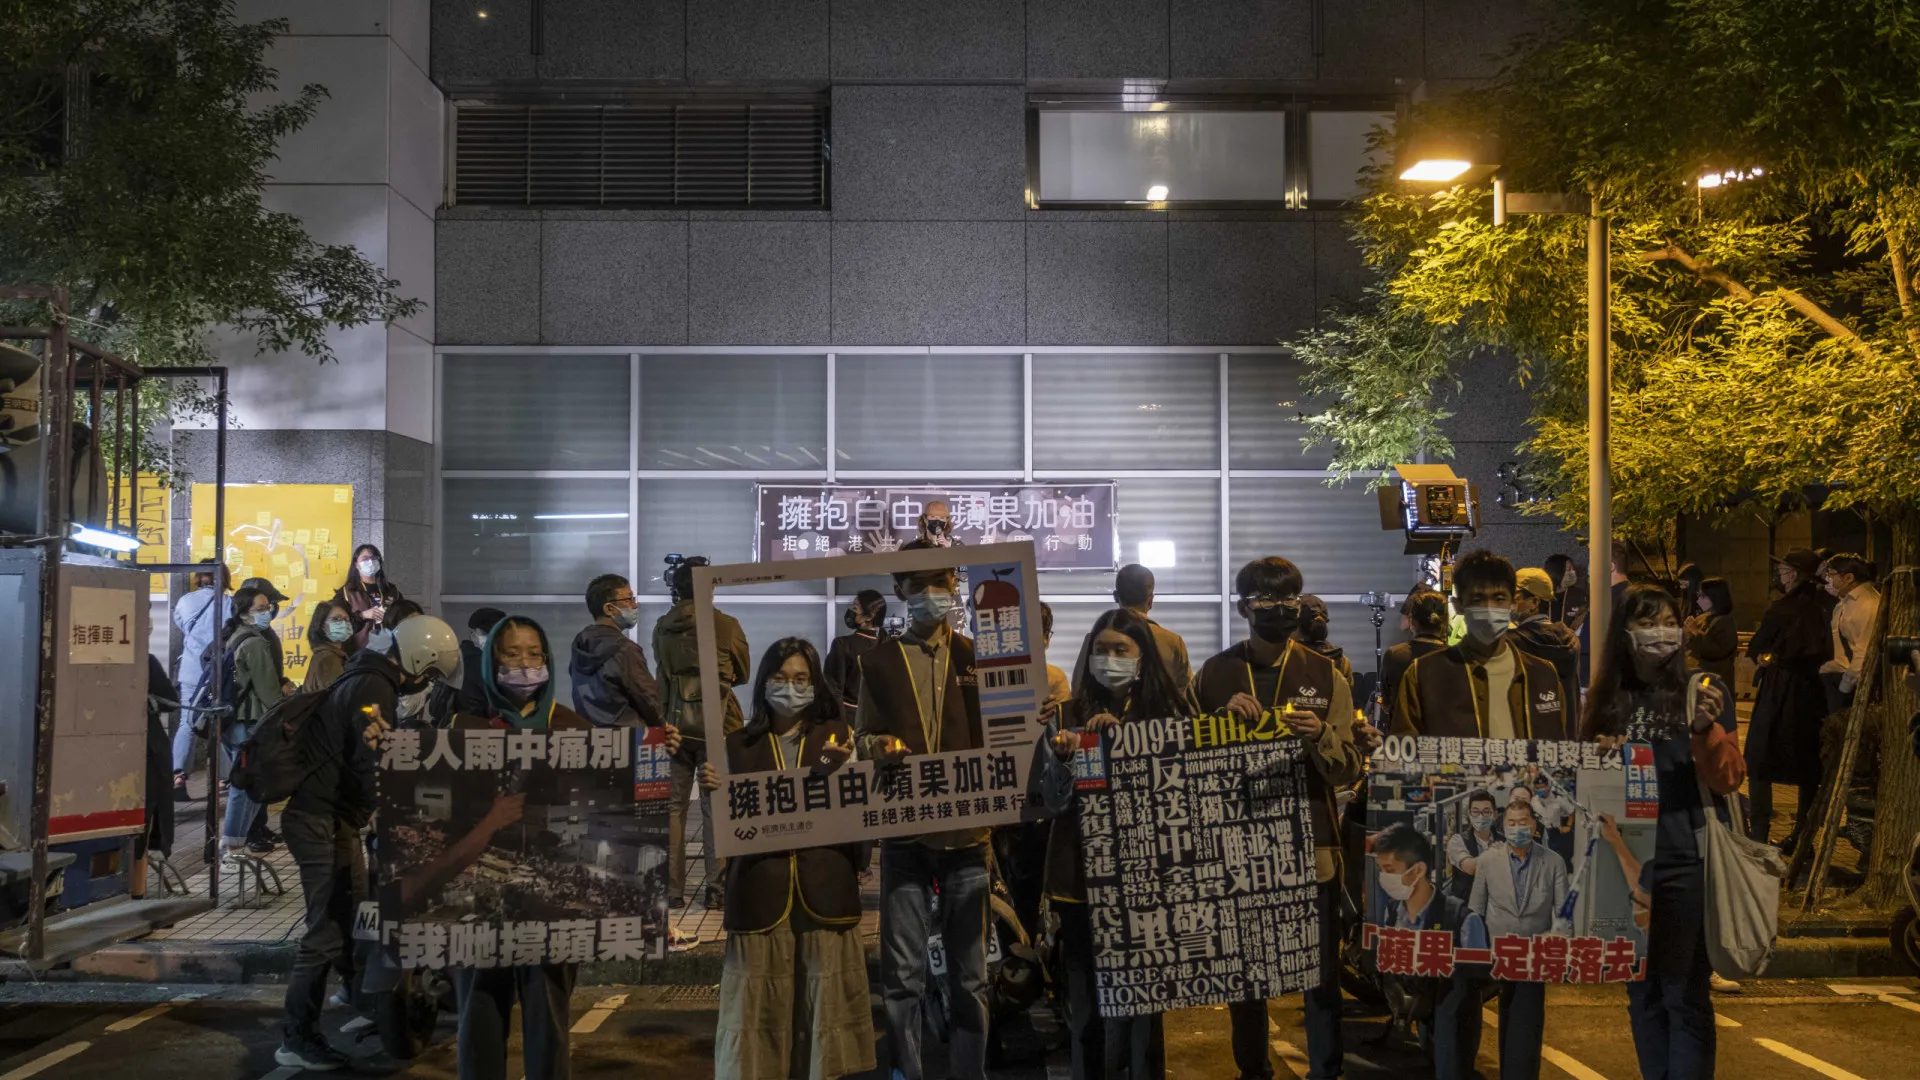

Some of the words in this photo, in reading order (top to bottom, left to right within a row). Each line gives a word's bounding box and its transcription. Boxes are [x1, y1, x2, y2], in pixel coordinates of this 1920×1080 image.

[778, 496, 924, 531] 擁抱自由
[950, 496, 1096, 531] 蘋果加油
[72, 623, 114, 651] 指揮車
[118, 614, 131, 645] 1
[379, 727, 630, 771] 港人雨中痛別
[728, 766, 868, 821] 擁抱自由
[882, 750, 1018, 803] 蘋果加油
[1152, 754, 1192, 864] 反送中
[1079, 794, 1118, 878] 光復香港
[1120, 857, 1159, 872] 721
[1122, 881, 1162, 896] 831
[358, 911, 382, 931] NA
[1129, 898, 1217, 968] 黑警
[382, 915, 665, 969] 「我哋撐蘋果」
[1361, 923, 1648, 984] 「蘋果一定撐落去」
[1095, 966, 1160, 988] FREE
[1097, 981, 1168, 1006] HONG
[1175, 972, 1245, 999] KONG
